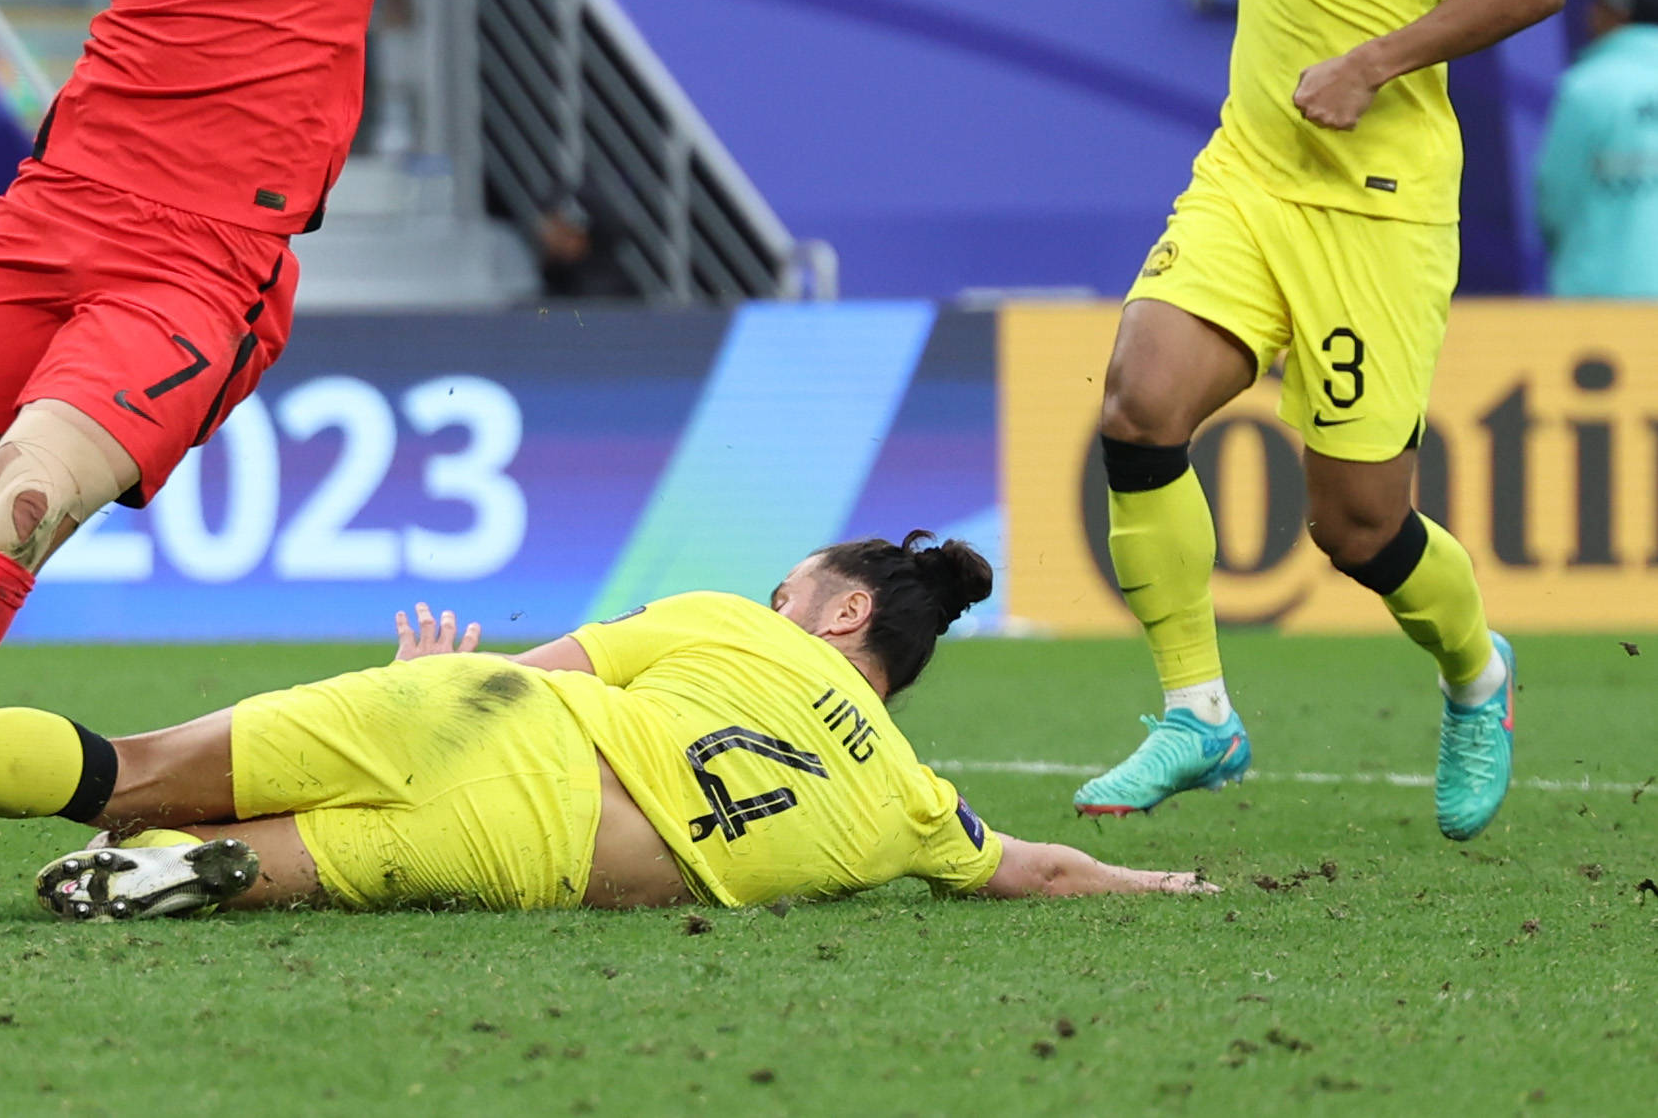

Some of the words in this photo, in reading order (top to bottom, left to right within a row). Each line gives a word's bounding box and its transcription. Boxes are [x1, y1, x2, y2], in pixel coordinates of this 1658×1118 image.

[143, 334, 212, 400] 7
[1322, 327, 1364, 409] 3
[685, 725, 831, 843] 4
